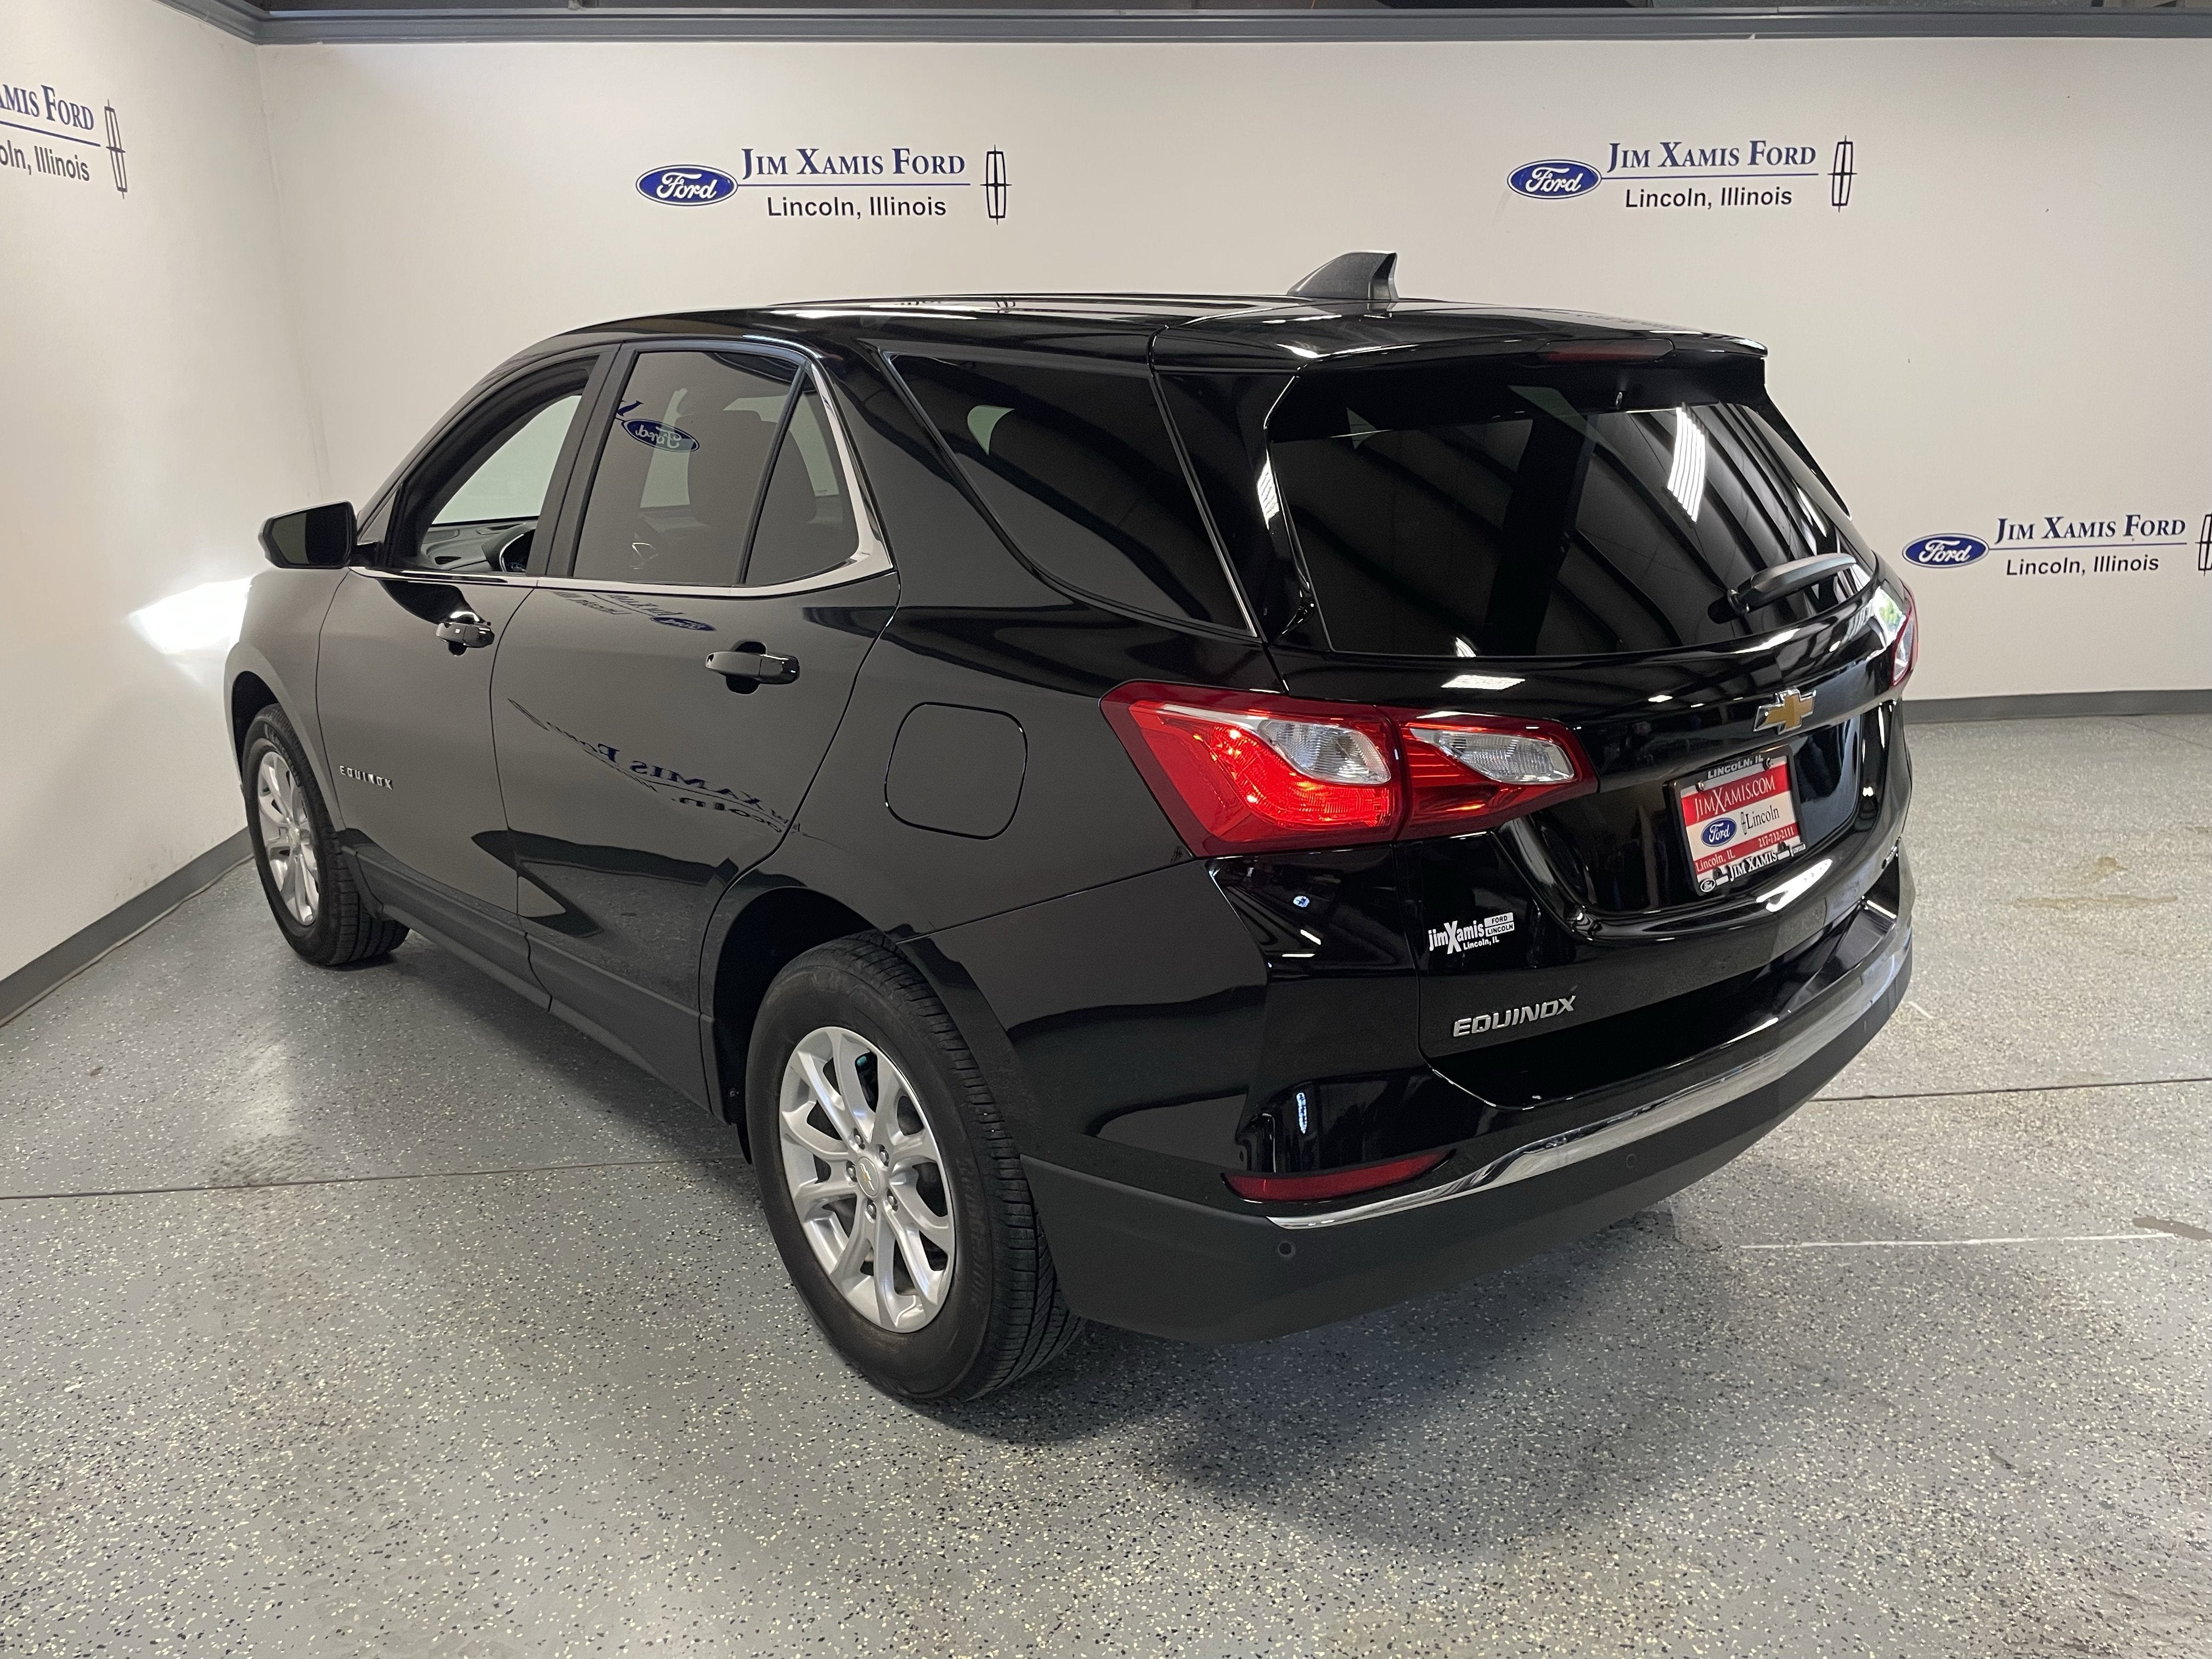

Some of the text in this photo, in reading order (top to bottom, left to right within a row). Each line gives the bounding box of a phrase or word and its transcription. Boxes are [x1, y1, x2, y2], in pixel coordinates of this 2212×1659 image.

[41, 84, 94, 130] FORD
[34, 145, 90, 181] Illinois
[741, 148, 965, 180] JIM XAMIS FORD
[1607, 140, 1816, 173] JIM XAMIS FORD
[656, 172, 718, 199] Ford
[1525, 167, 1584, 192] Ford
[768, 196, 946, 219] Lincoln, Illinois
[1626, 187, 1792, 210] Lincoln, Illinois
[1995, 514, 2186, 544] JIM XAMIS FORD
[1918, 539, 1972, 562] Ford
[2006, 554, 2159, 575] Lincoln, Illinois
[340, 765, 393, 790] EQUINOX
[1707, 755, 1764, 780] LINCOLN, IL
[1694, 775, 1776, 822] JIMXAMIS.COM
[1745, 805, 1779, 830] Lincoln
[1708, 822, 1730, 843] Ford
[1758, 826, 1794, 848] 217-732-2111
[1696, 850, 1735, 872] Lincoln, IL
[1729, 851, 1778, 882] JIM XAMIS
[1487, 923, 1514, 935] LINCOLN
[1491, 915, 1508, 924] FORD
[1463, 938, 1491, 950] Lincoln,
[1453, 995, 1576, 1037] EQUINOX
